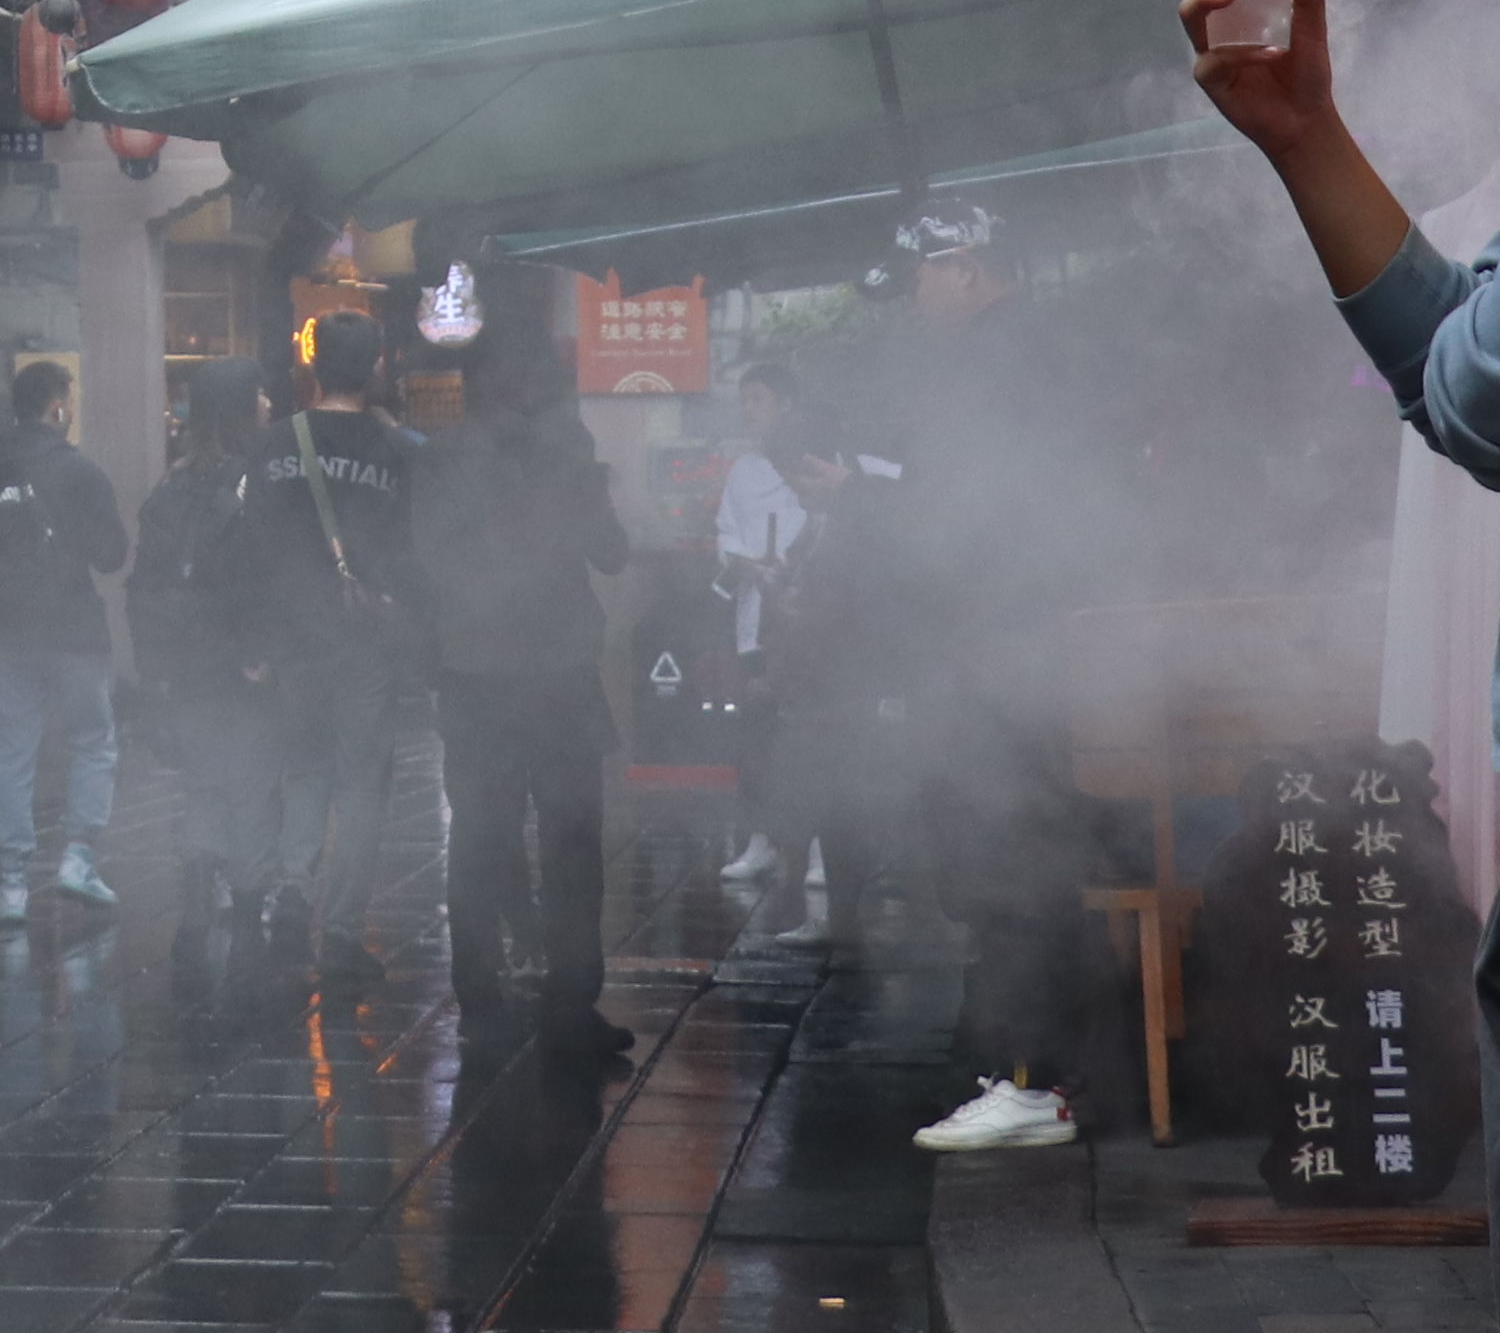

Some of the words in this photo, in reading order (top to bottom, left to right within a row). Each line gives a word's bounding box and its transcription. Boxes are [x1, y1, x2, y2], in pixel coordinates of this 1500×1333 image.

[1274, 769, 1332, 960] 汉服摄影
[1350, 768, 1407, 959] 化妆造型
[1284, 994, 1345, 1184] 汉服出租
[1364, 988, 1415, 1176] 请上二楼
